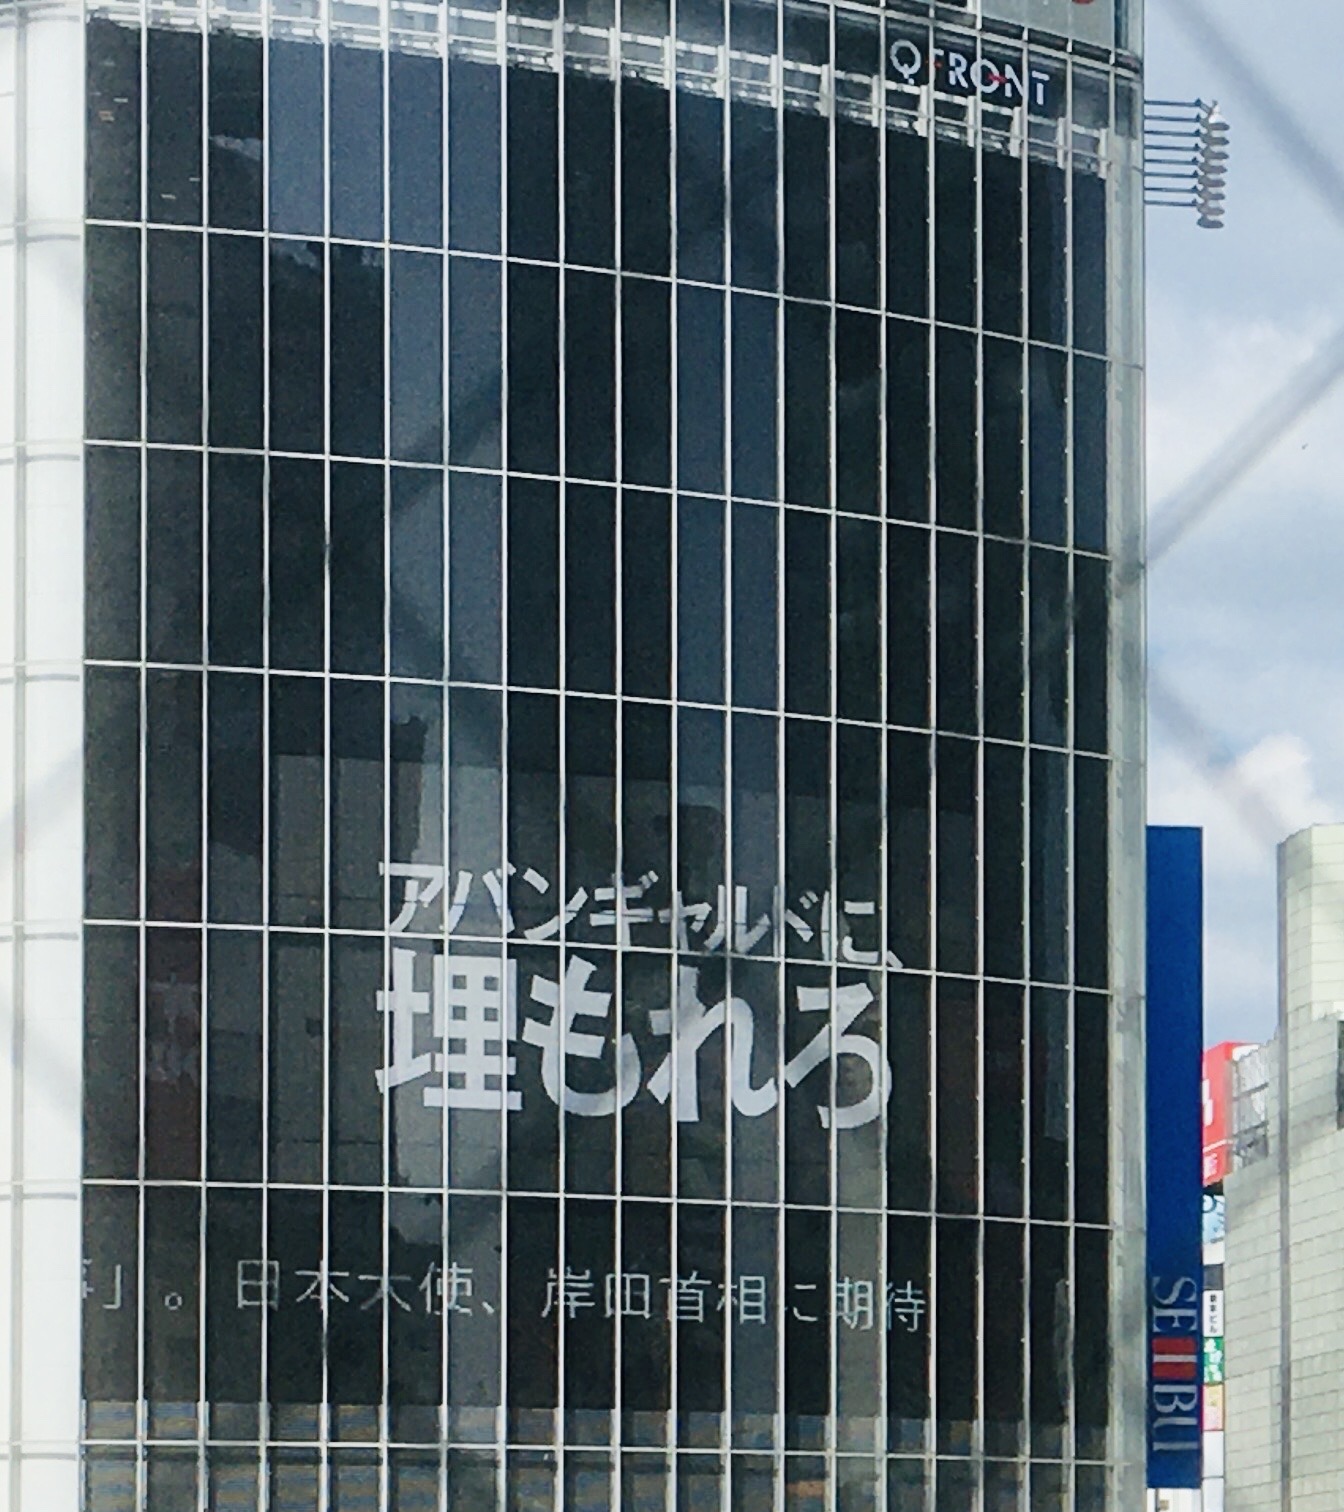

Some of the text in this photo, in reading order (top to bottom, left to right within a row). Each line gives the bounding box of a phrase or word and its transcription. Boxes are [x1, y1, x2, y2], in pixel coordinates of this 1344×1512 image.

[375, 948, 892, 1130] 埋もれろ
[1152, 1276, 1198, 1451] SEIBU
